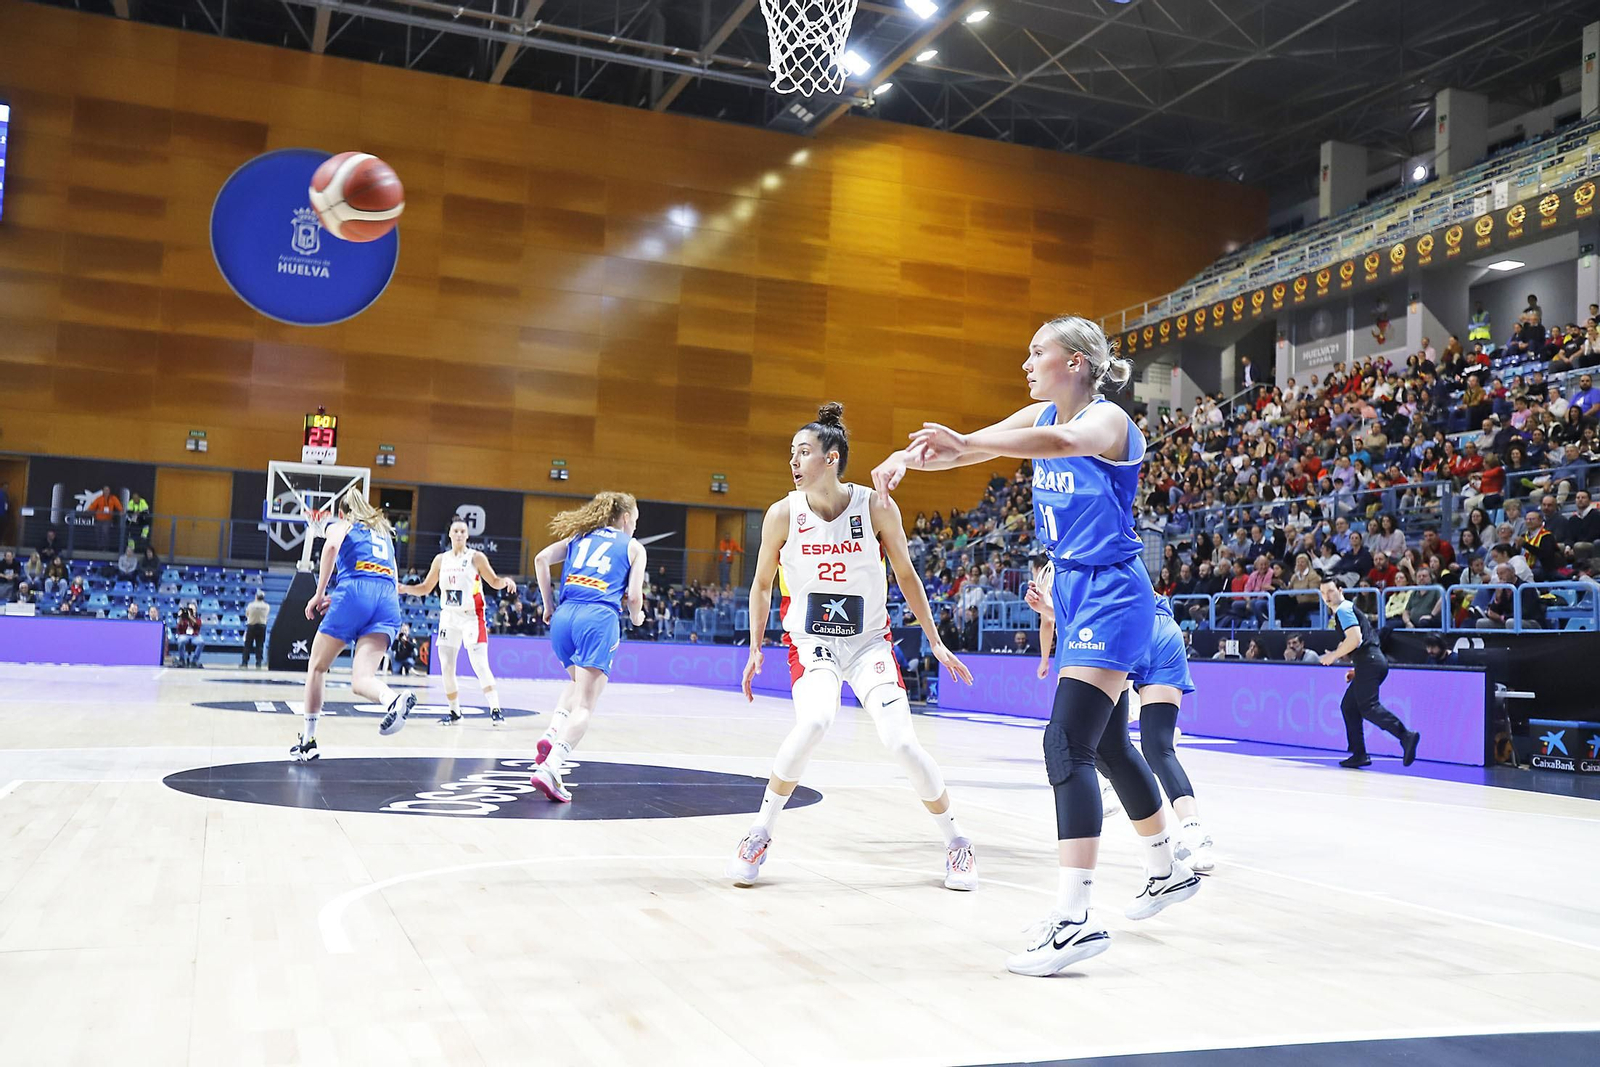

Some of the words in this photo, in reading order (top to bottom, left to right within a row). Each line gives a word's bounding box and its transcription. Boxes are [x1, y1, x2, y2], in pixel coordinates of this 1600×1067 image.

[277, 262, 330, 278] HUELVA
[308, 428, 335, 448] 23
[1038, 503, 1058, 542] 11
[369, 528, 390, 560] 5
[801, 540, 863, 556] ESPAÑA
[571, 537, 613, 576] 14
[817, 562, 847, 582] 22
[811, 622, 856, 637] CaixaBank
[1068, 641, 1106, 651] Kristall
[1231, 677, 1413, 742] endea
[1532, 757, 1575, 771] CaixaBank
